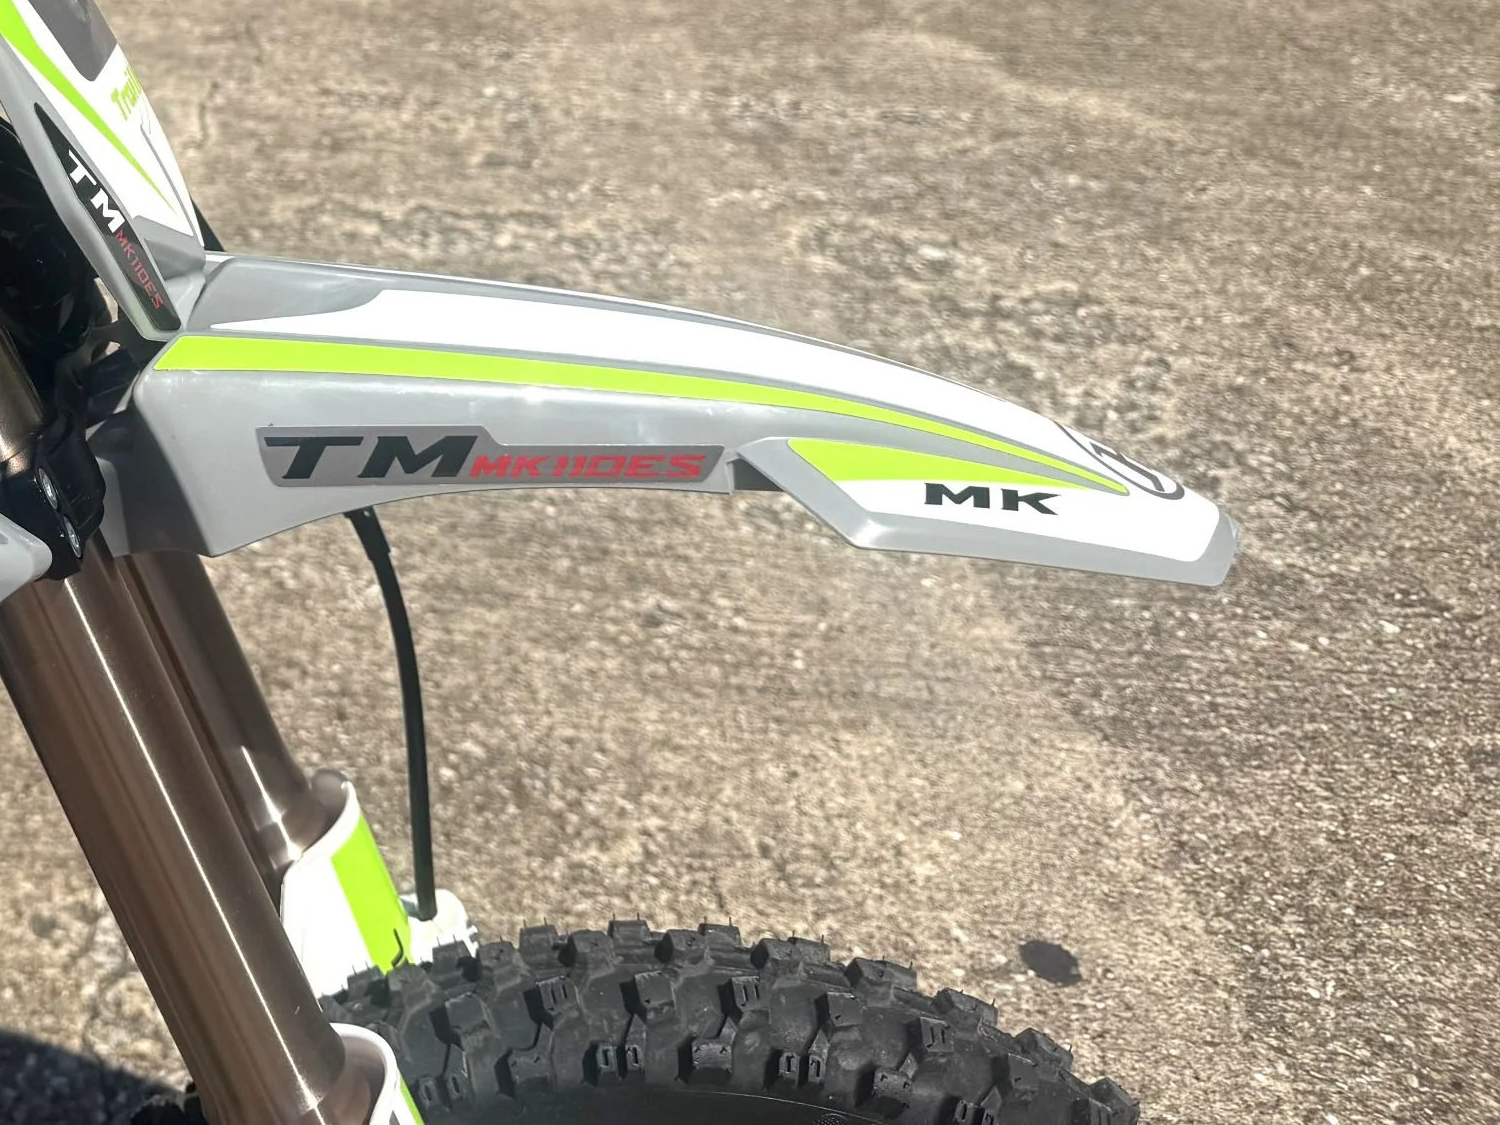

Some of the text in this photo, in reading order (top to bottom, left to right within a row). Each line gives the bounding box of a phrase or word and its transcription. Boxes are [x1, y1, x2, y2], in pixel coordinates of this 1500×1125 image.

[68, 149, 164, 309] TM MK110ES
[264, 435, 707, 479] TM MK110ES
[924, 483, 1061, 515] MK
